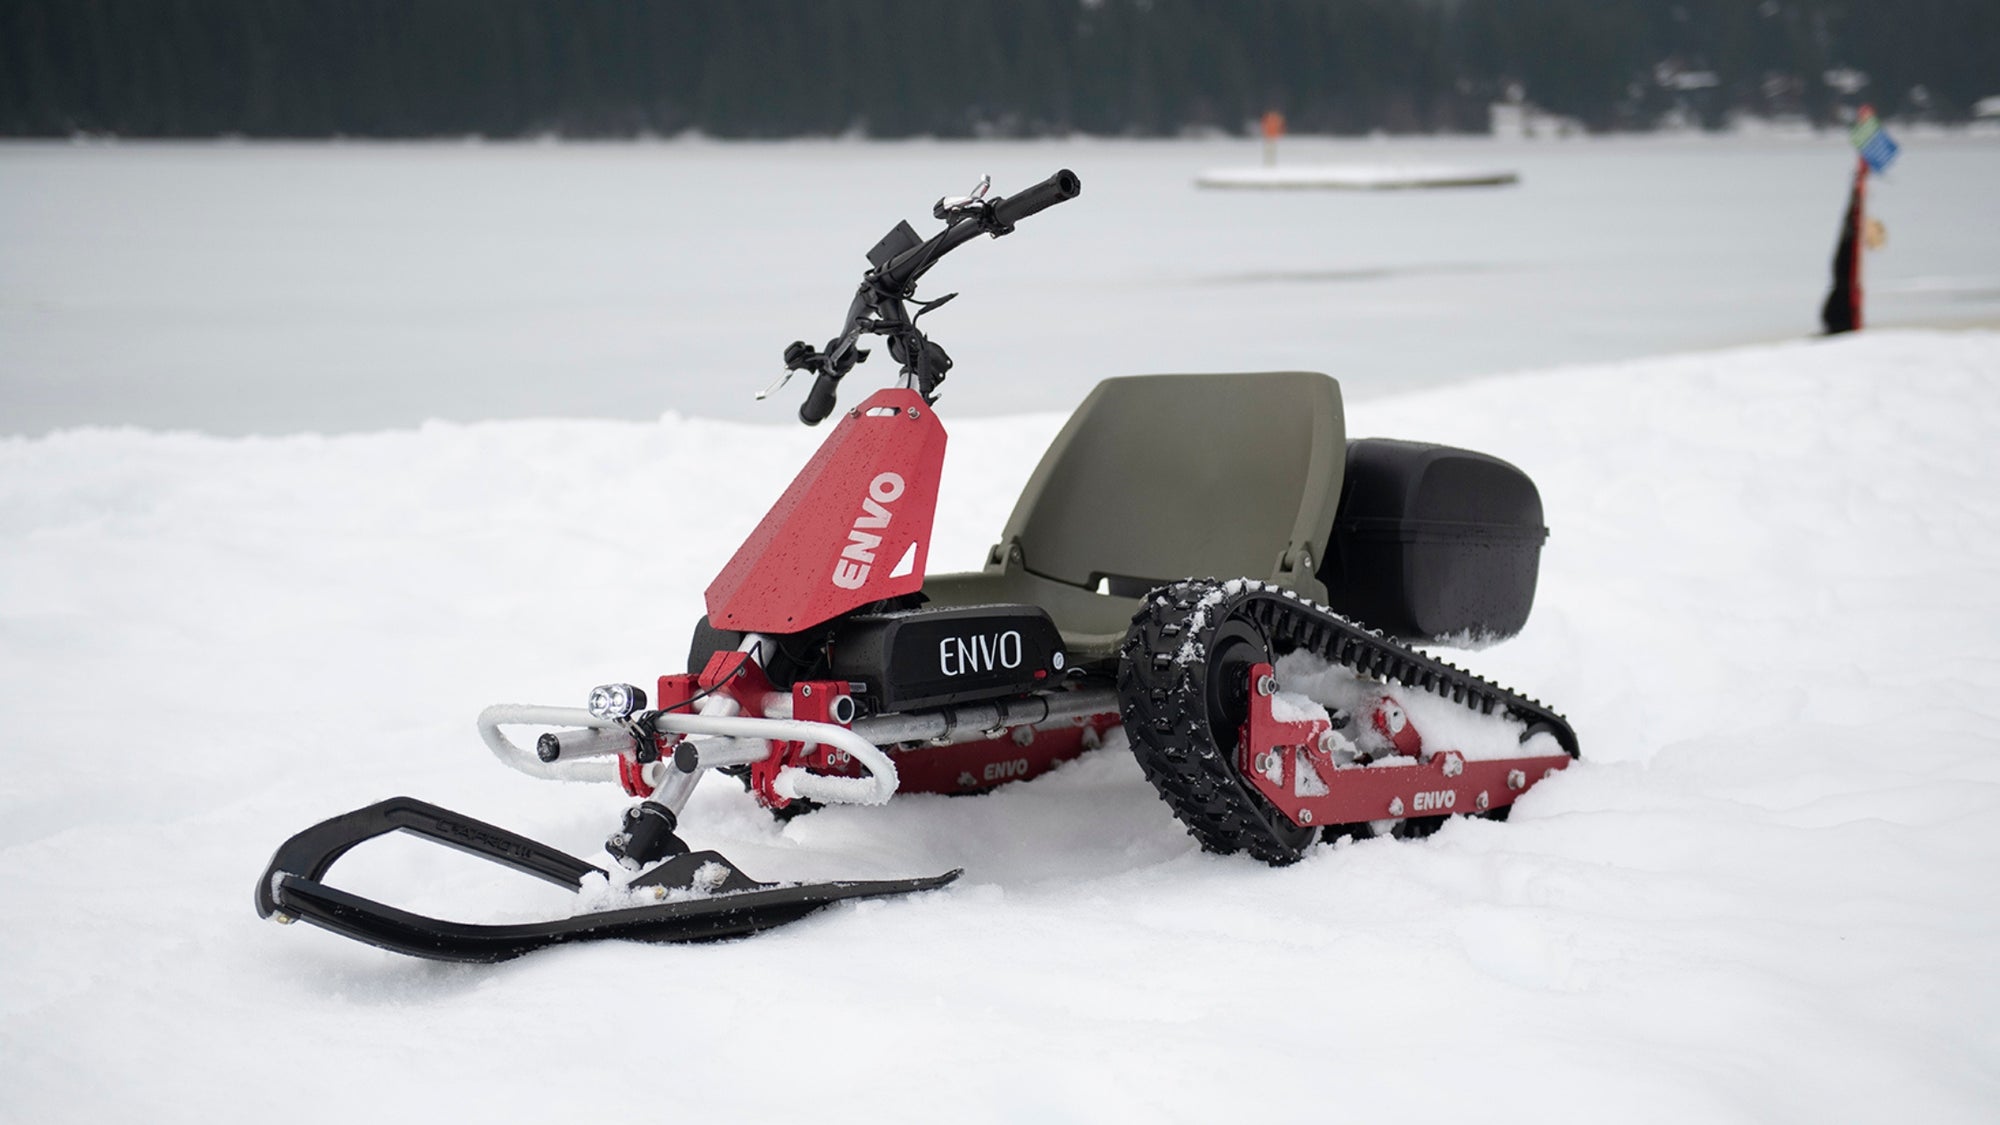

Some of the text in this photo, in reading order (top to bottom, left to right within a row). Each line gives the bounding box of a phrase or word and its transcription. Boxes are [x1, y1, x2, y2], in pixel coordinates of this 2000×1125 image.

[832, 472, 905, 589] ENVO
[940, 630, 1022, 676] ENVO
[984, 759, 1028, 780] ENVO
[1413, 790, 1456, 811] ENVO
